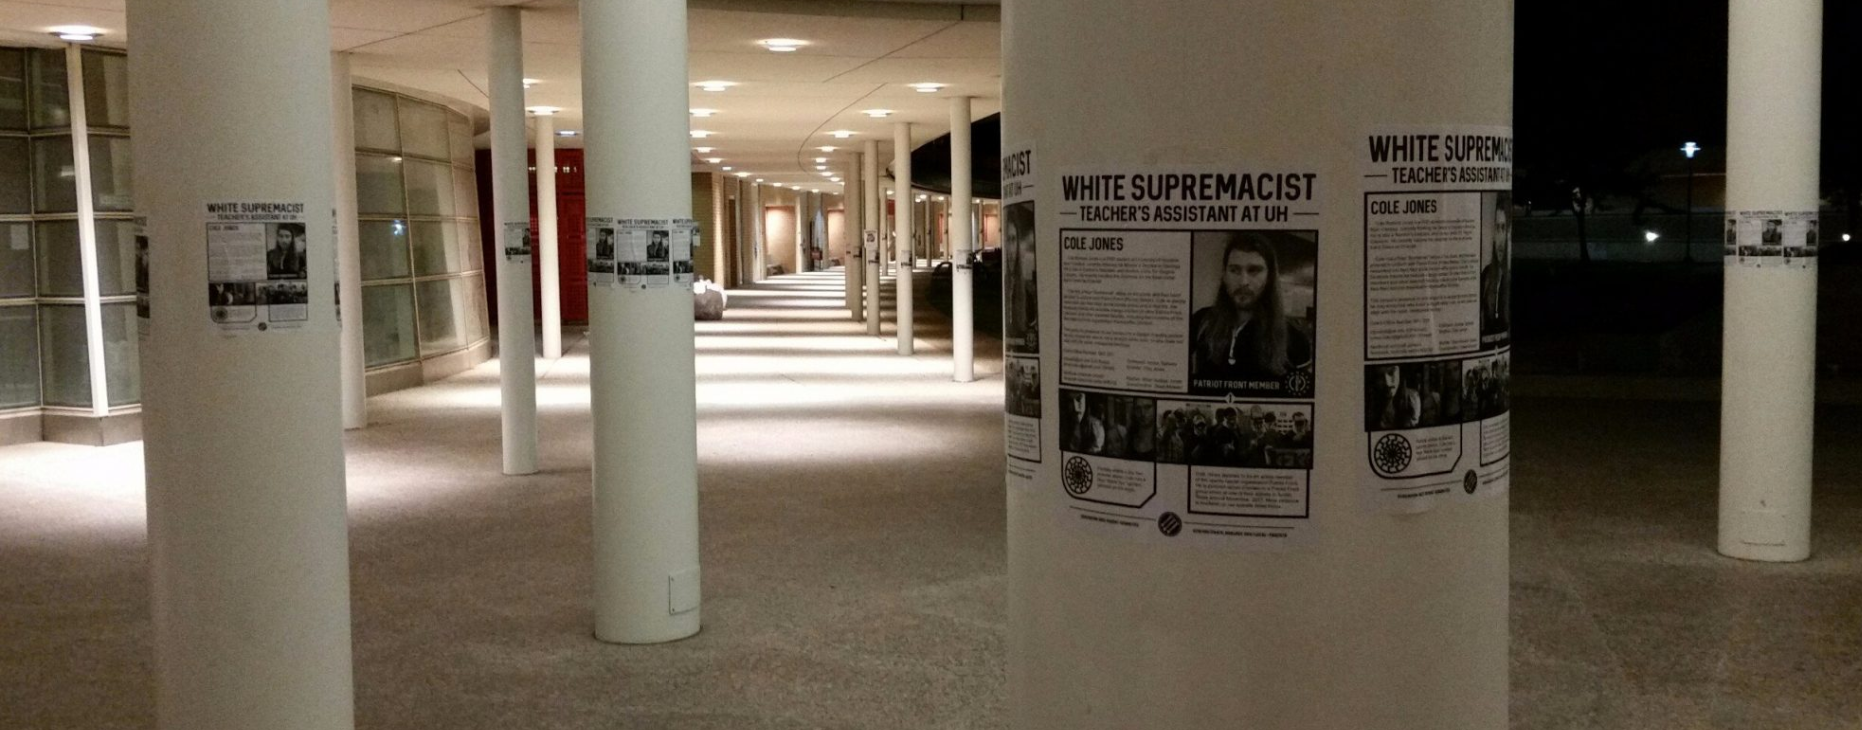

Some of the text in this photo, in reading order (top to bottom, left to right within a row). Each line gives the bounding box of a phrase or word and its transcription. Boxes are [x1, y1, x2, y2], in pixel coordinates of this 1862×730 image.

[1369, 134, 1440, 163] WHITE
[1392, 166, 1457, 184] TEACHER'S
[1459, 167, 1500, 183] ASSISTANT
[1062, 172, 1317, 201] WHITE SUPREMACIST
[207, 202, 304, 213] WHITE SUPREMACIST
[1080, 205, 1288, 222] TEACHER'S ASSISTANT AT UH
[1371, 199, 1438, 215] COLE JONES
[1064, 236, 1124, 251] COLE JONES
[1193, 379, 1280, 390] PATRIOT FRONT MEMBER
